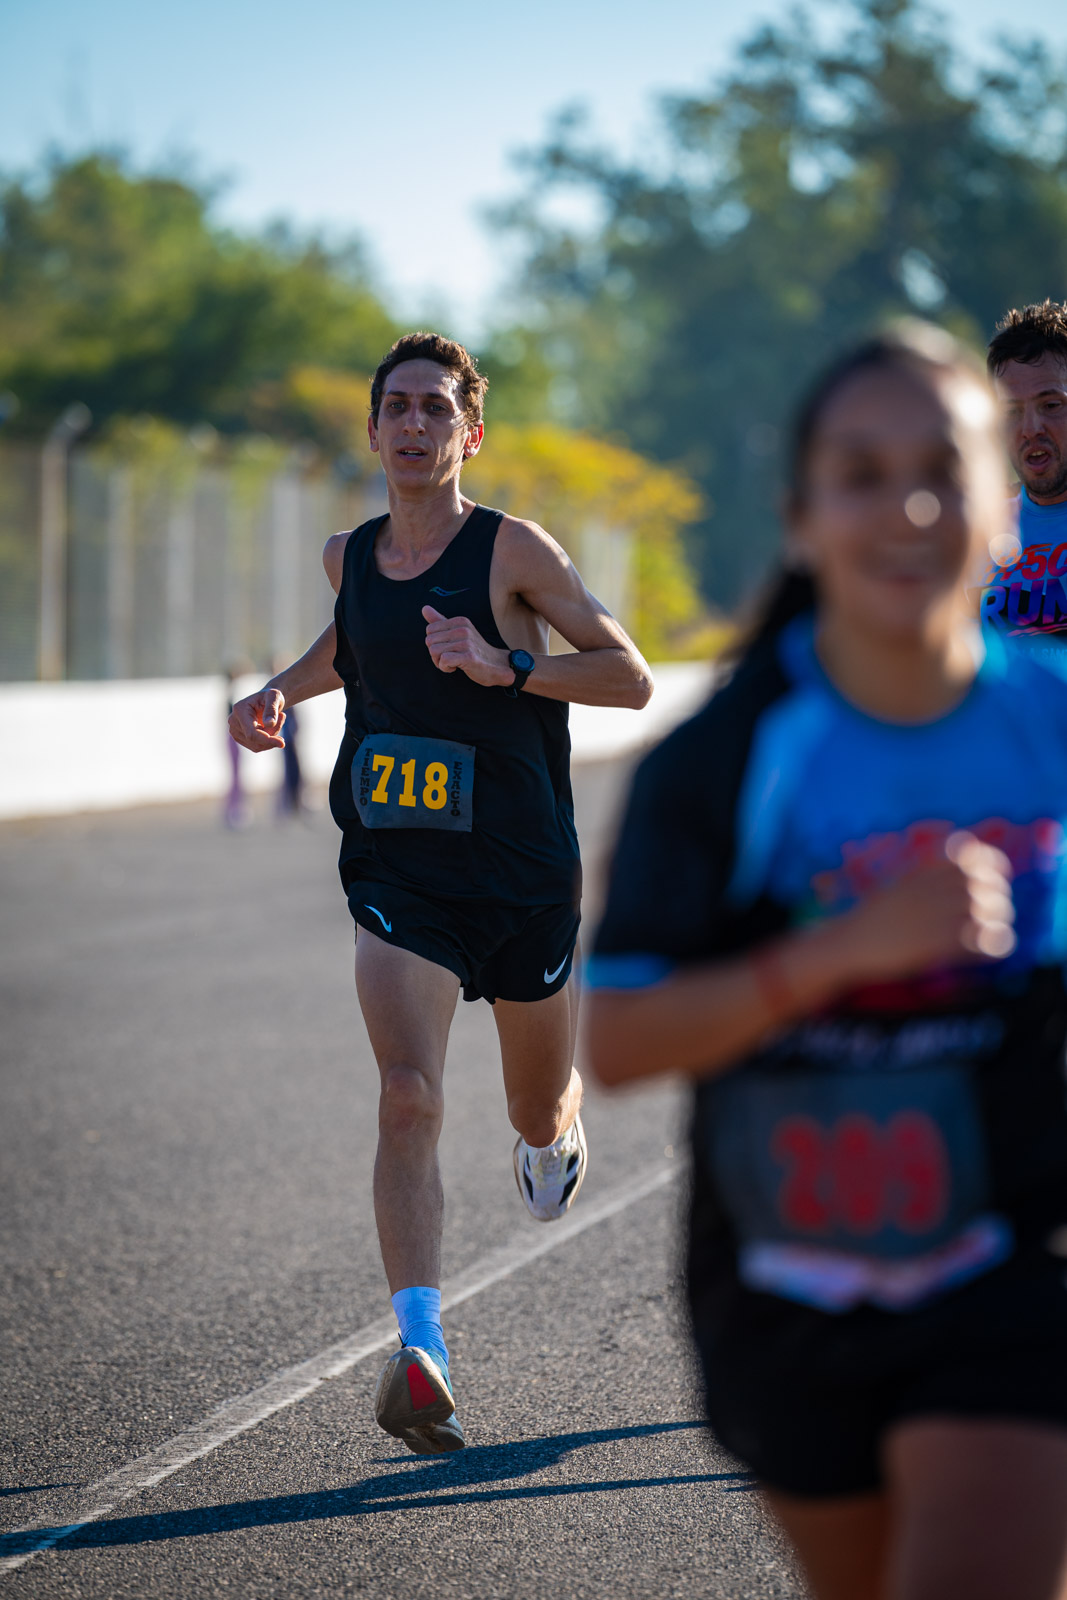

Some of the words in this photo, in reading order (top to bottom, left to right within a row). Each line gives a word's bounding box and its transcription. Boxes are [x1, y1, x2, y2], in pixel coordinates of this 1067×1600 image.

[360, 748, 373, 806] TIEMPO
[371, 754, 449, 810] 718
[450, 761, 462, 816] EXACTO
